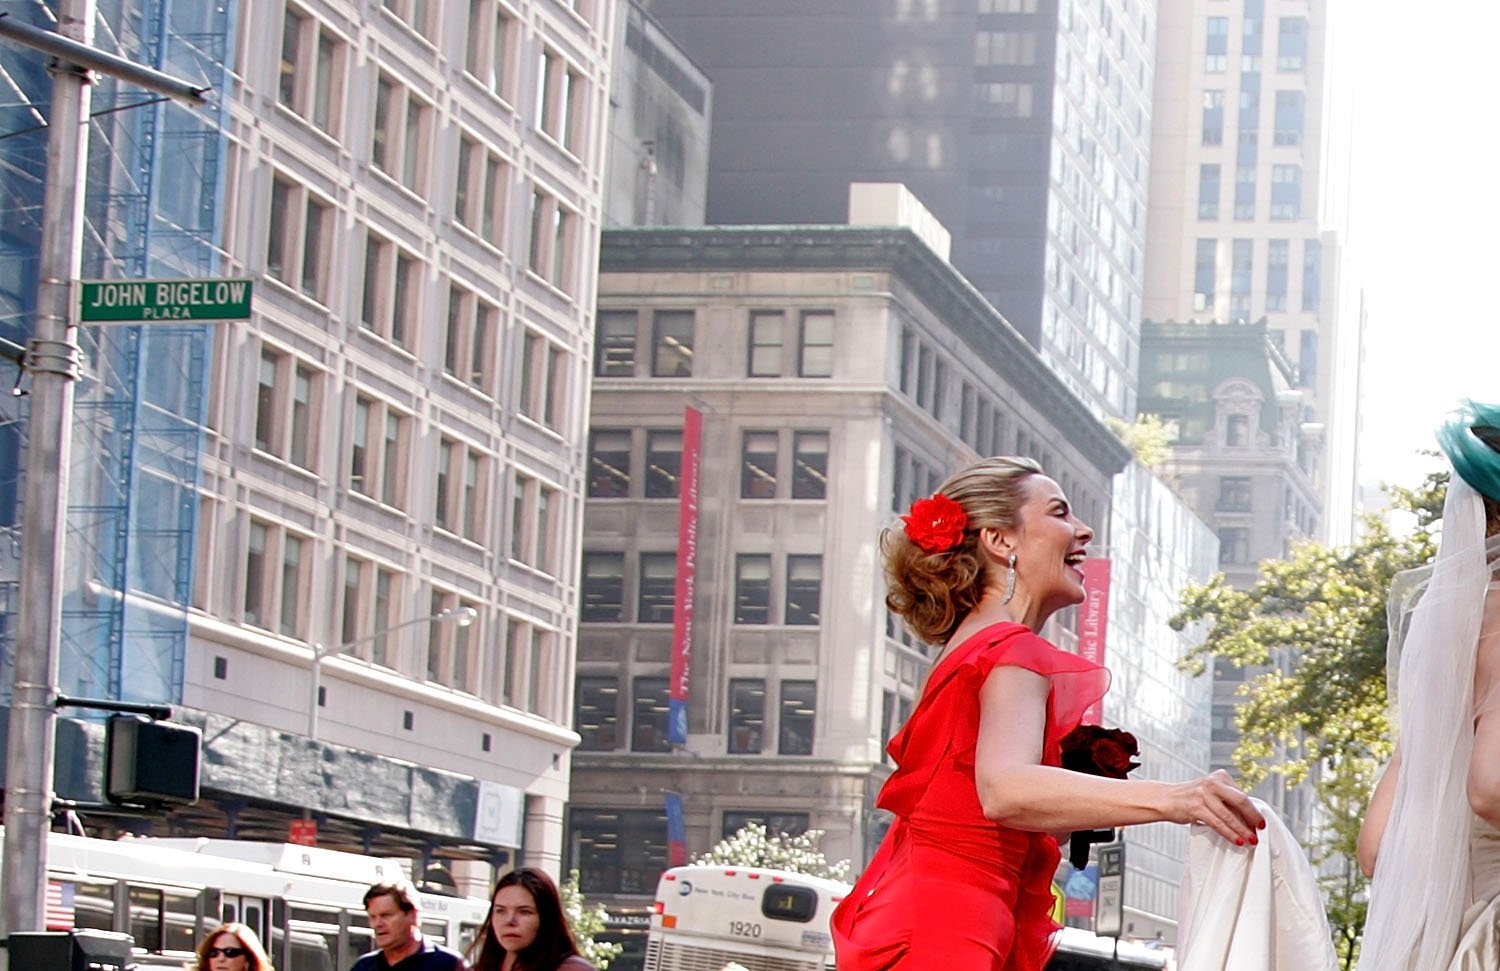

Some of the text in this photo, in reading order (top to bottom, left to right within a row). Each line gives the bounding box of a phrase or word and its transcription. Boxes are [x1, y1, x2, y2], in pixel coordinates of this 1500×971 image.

[91, 281, 246, 307] JOHN BIGELOW
[142, 306, 191, 320] PLAZA
[1085, 588, 1103, 636] Library
[608, 915, 651, 925] AXAZRIA
[729, 919, 762, 939] 1920
